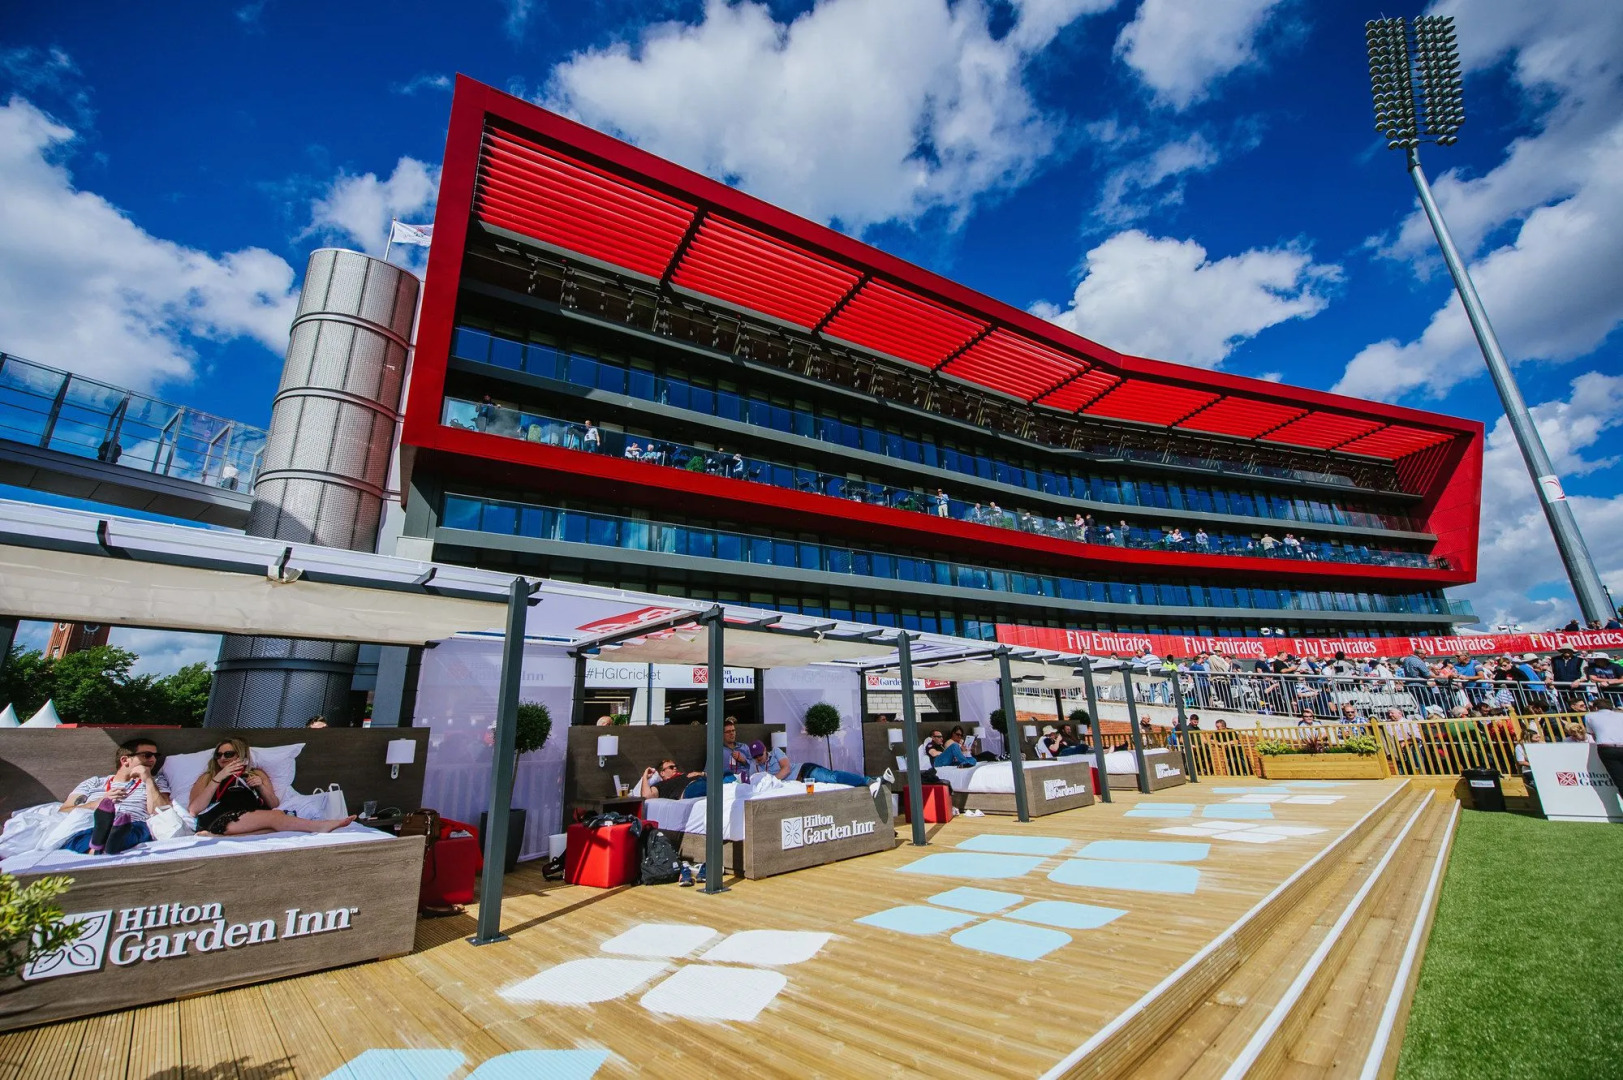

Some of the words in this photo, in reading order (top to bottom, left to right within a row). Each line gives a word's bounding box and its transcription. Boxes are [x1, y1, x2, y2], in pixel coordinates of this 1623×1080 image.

[1066, 630, 1090, 653] Fly
[1092, 633, 1152, 651] Emirates
[1183, 637, 1207, 654] Fly
[1207, 638, 1264, 654] Emirates
[1294, 639, 1319, 657] Fly
[1320, 639, 1377, 654] Emirates
[1409, 637, 1434, 655] Fly
[1435, 636, 1496, 652] Emirates
[1530, 633, 1556, 651] Fly
[1555, 631, 1623, 648] Emirates
[586, 667, 661, 681] #HGICricket
[879, 677, 902, 687] Garde
[1579, 778, 1614, 787] Gard
[803, 814, 834, 829] Hilton
[803, 823, 852, 845] Garden
[116, 902, 223, 933] Hilton
[109, 918, 277, 966] Garden
